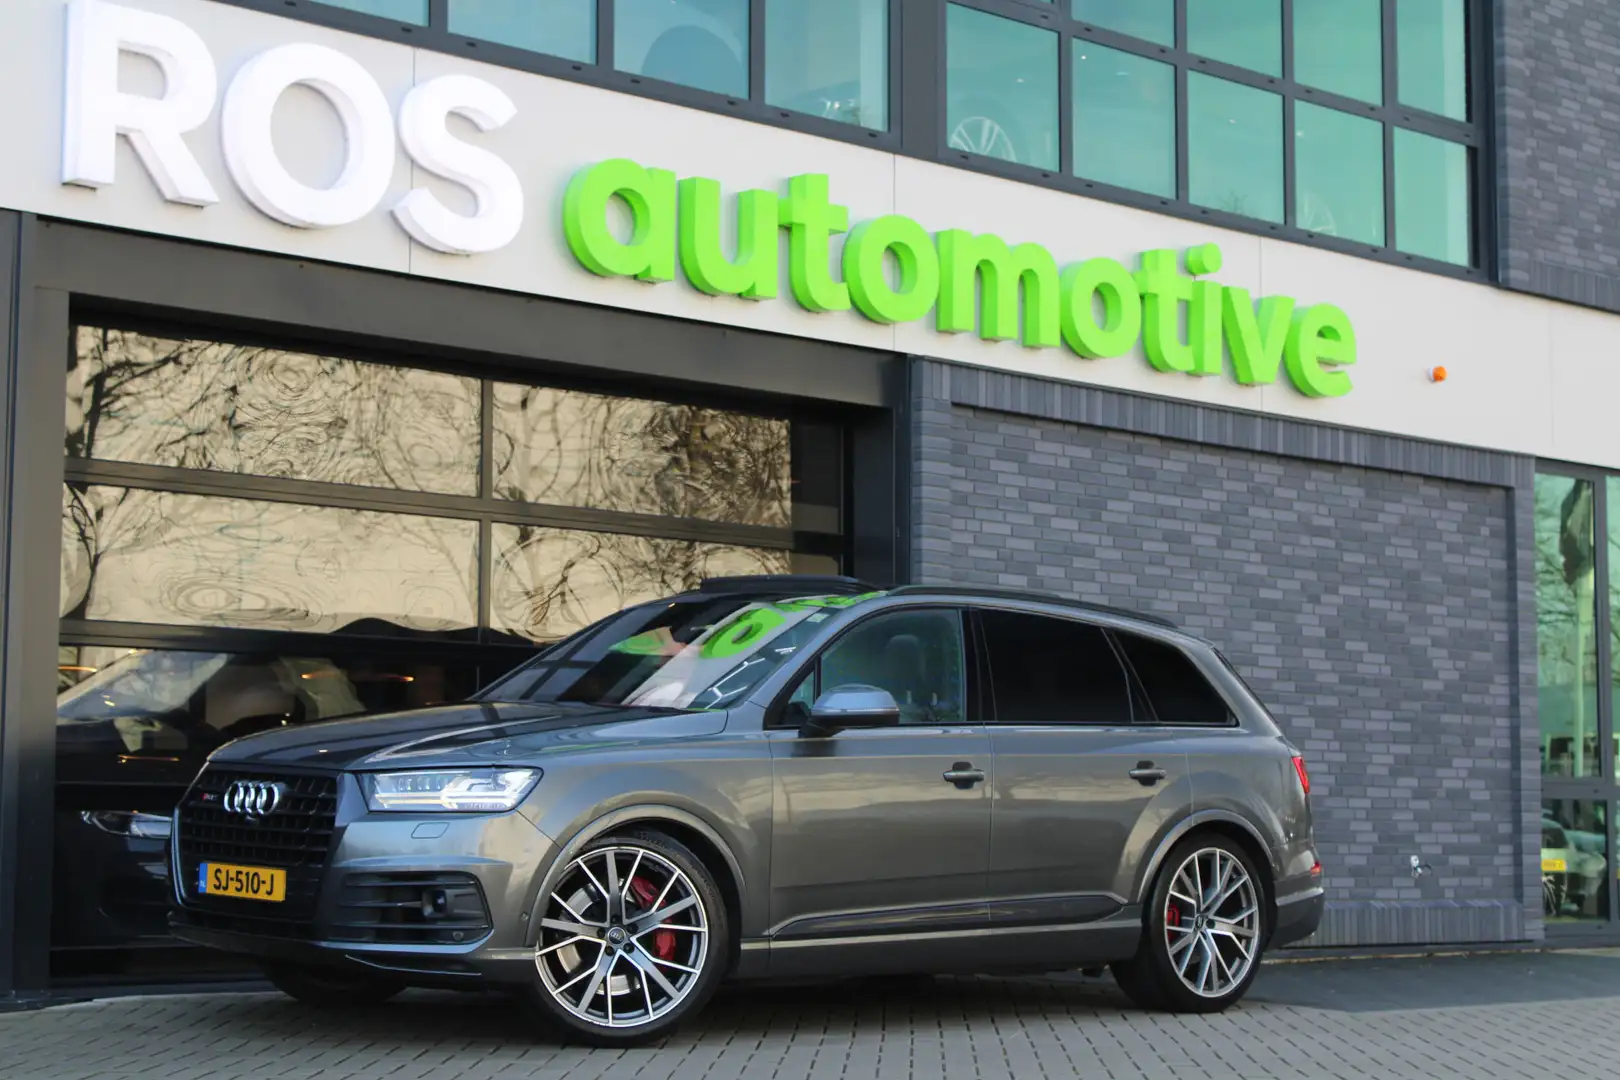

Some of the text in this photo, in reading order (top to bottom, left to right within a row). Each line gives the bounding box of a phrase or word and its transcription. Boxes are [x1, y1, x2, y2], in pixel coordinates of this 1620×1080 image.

[61, 1, 1357, 398] ROS automotive
[213, 867, 275, 896] SJ-510-J
